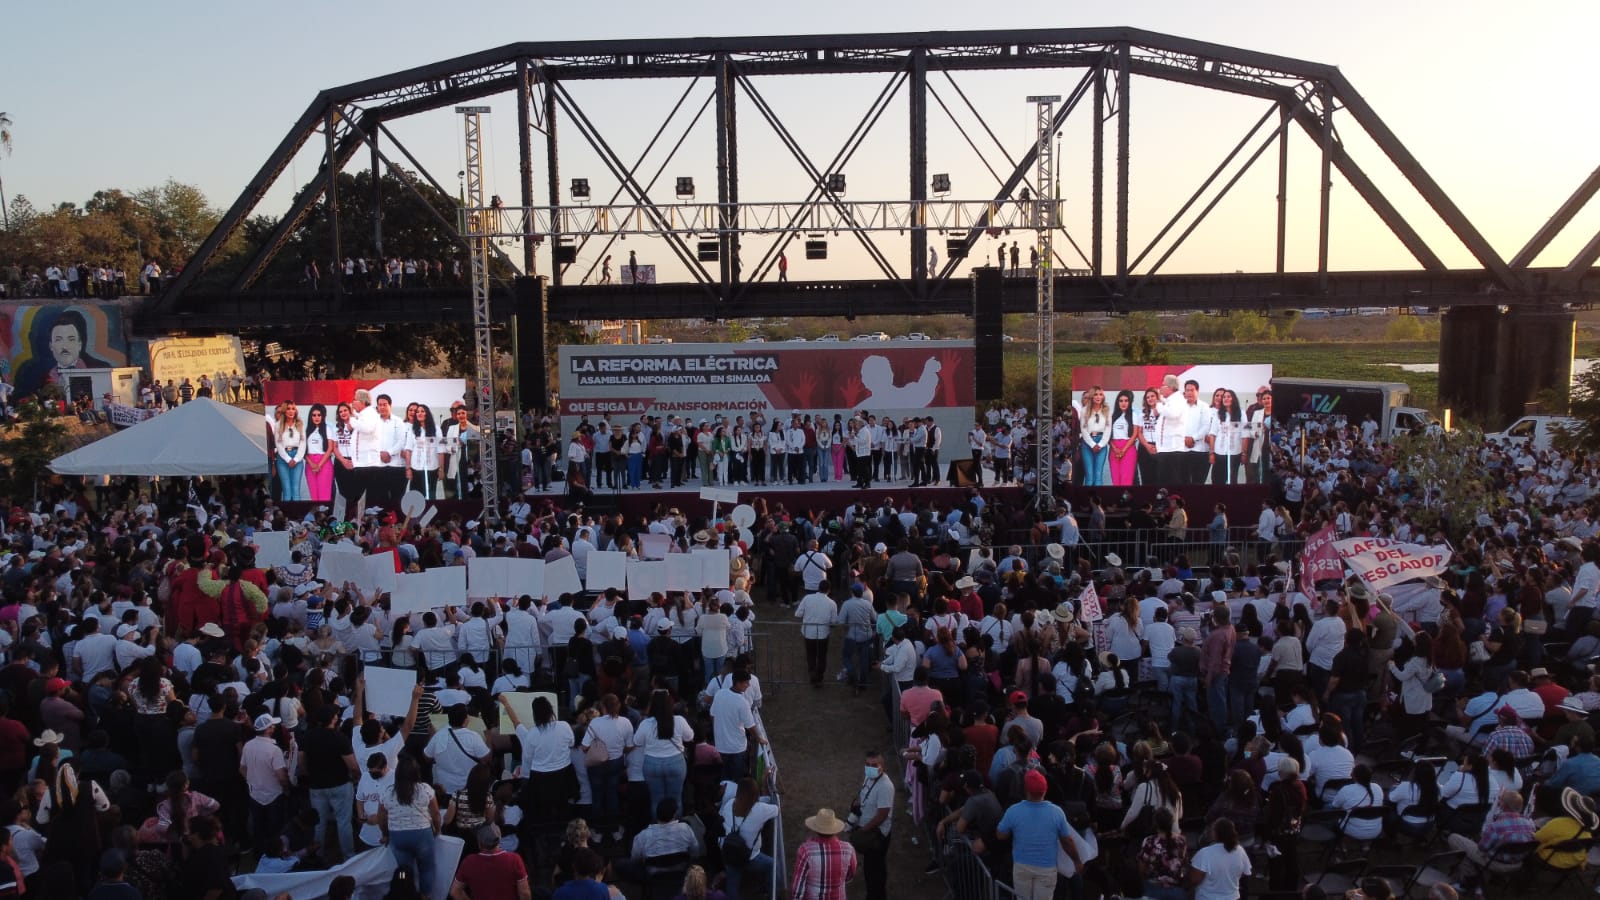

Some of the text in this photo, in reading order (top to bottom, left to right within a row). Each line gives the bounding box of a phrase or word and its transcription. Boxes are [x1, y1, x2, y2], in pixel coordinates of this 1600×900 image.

[572, 356, 778, 372] LA REFORMA ELÉCTRICA
[579, 374, 771, 385] ASAMBLEA INFORMATIVA EN SINALOA
[568, 399, 767, 412] QUE SIGA LA TRANSFORMACIÓN
[1375, 548, 1411, 562] DEL
